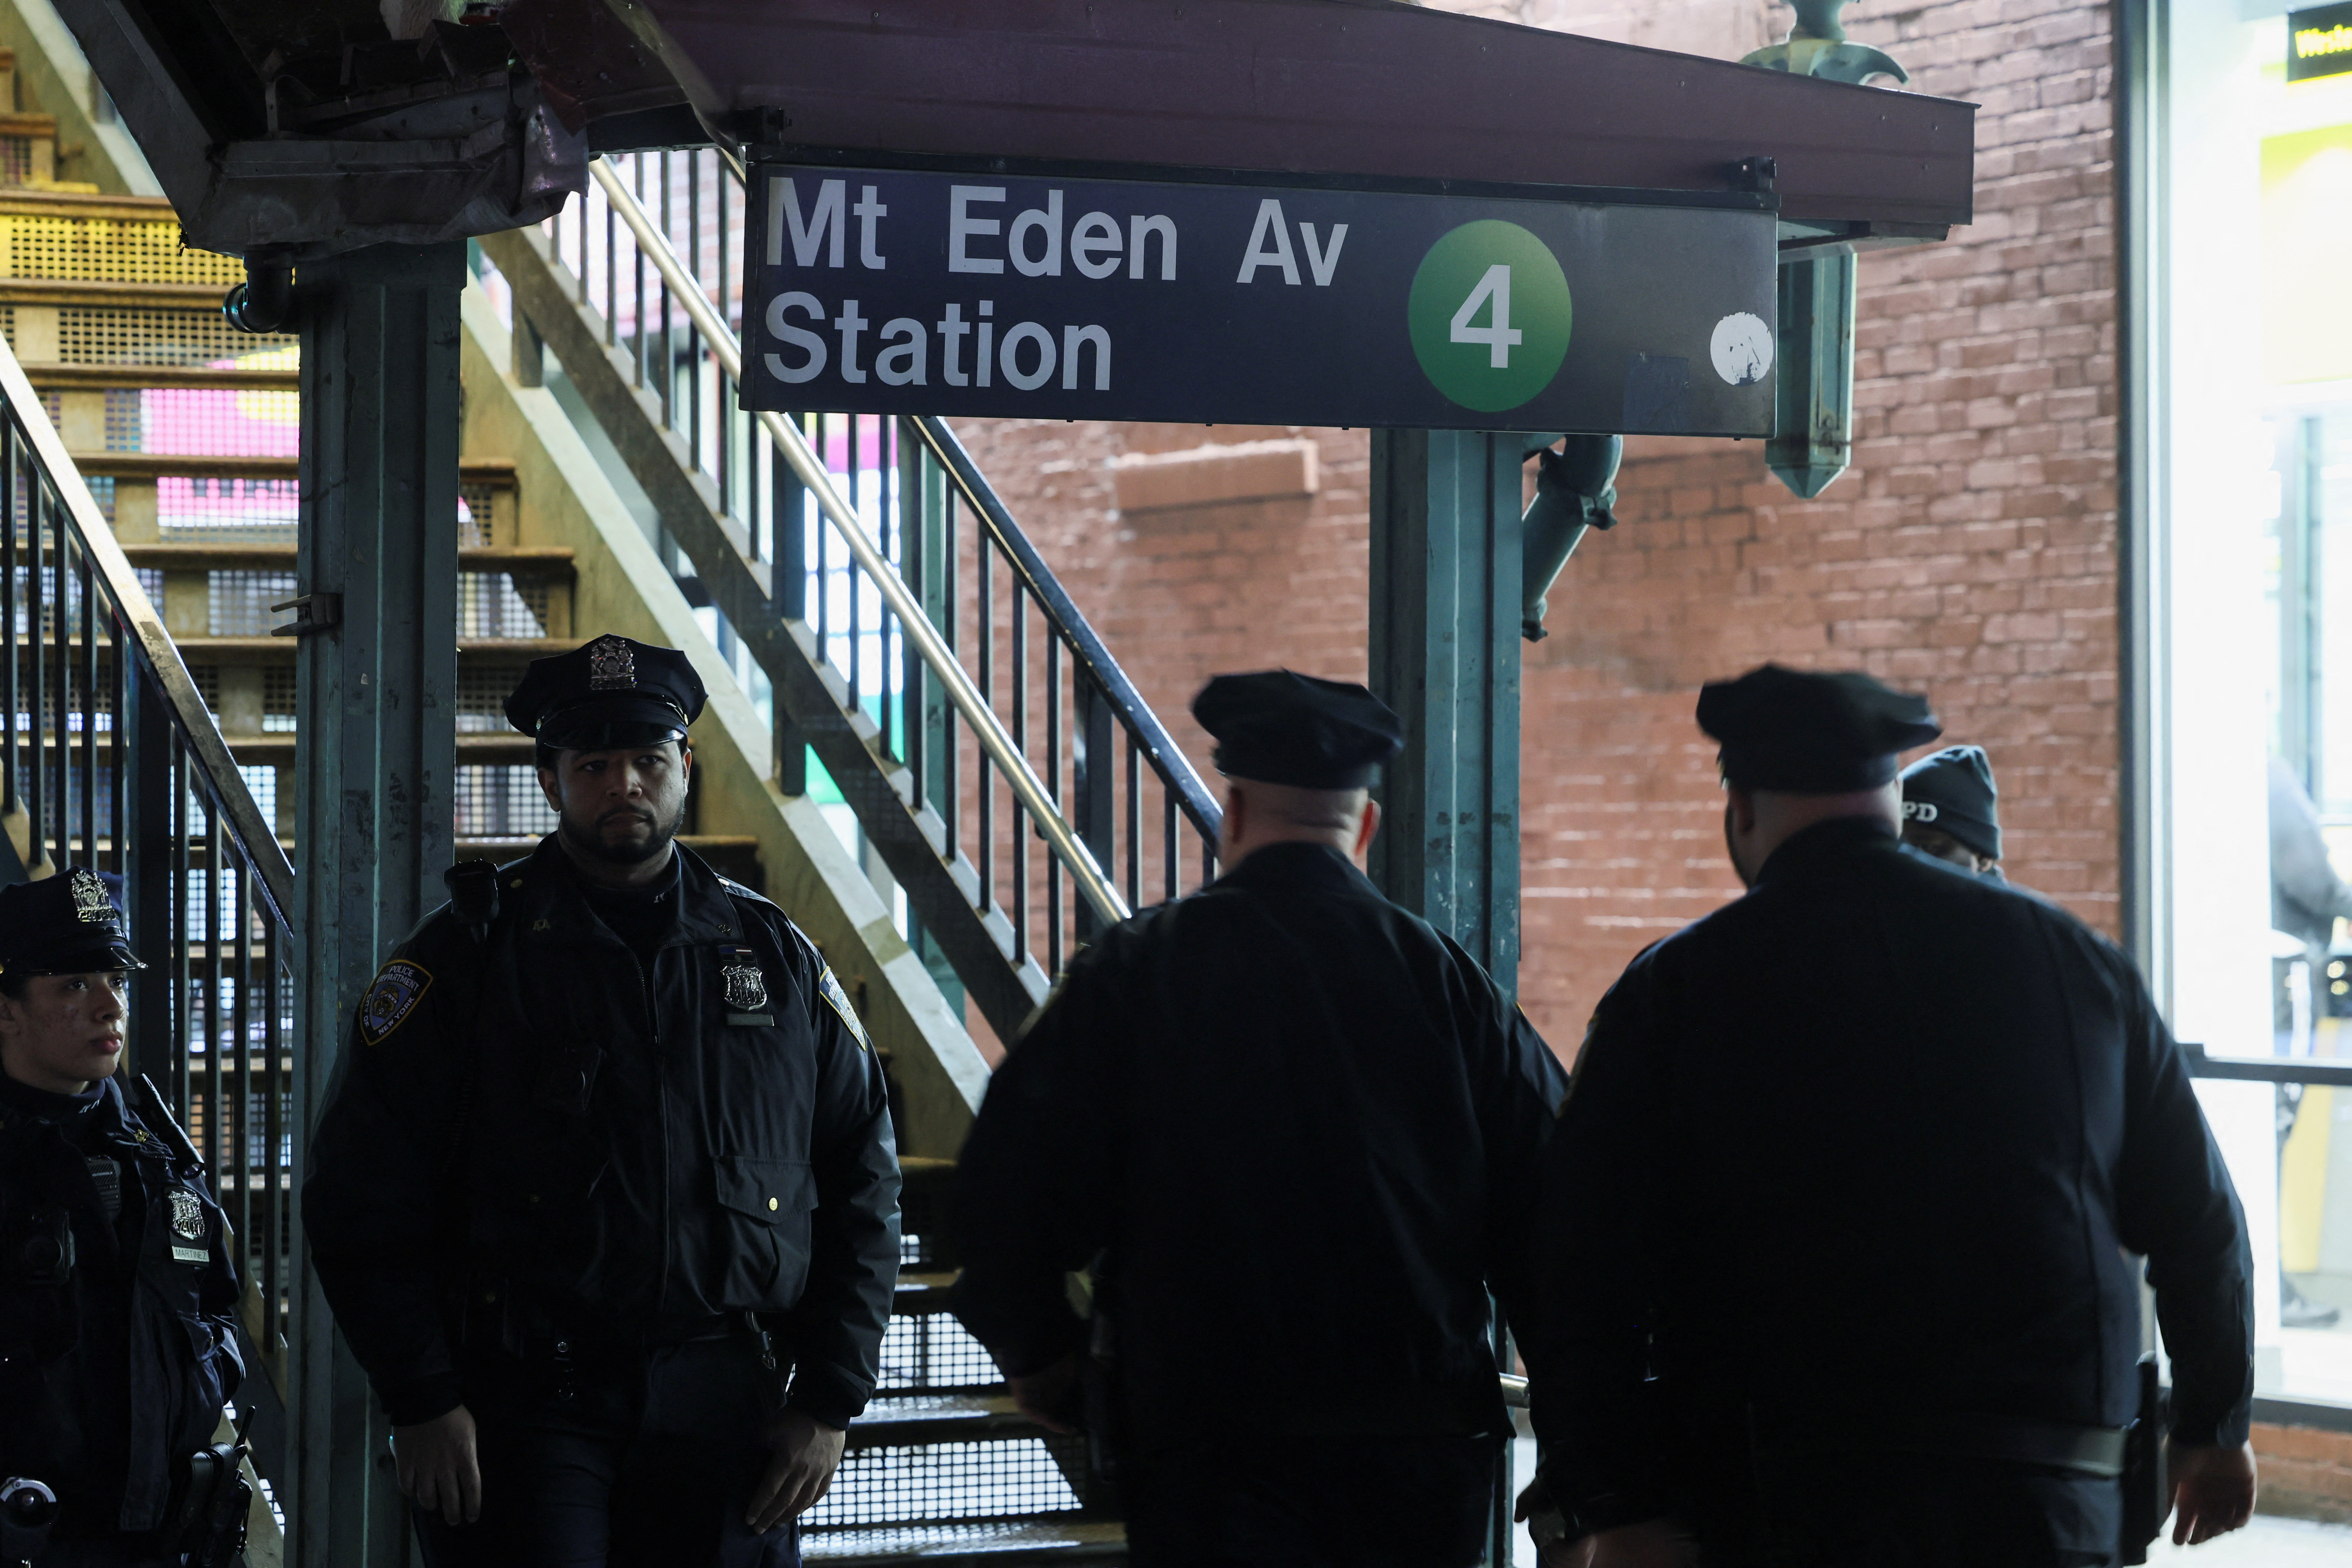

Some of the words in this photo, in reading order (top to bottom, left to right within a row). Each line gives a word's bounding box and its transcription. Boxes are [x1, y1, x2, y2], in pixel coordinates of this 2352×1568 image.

[766, 177, 887, 270] Mt
[948, 185, 1177, 281] Eden
[1236, 198, 1349, 286] Av
[1450, 264, 1522, 368] 4
[764, 291, 1111, 390] Station
[377, 974, 419, 991] DEPARTMENT
[389, 966, 414, 977] POLICE
[363, 1016, 369, 1026] OF
[378, 1019, 394, 1035] NEW
[394, 997, 415, 1019] YORK
[175, 1249, 207, 1260] MARTINEZ
